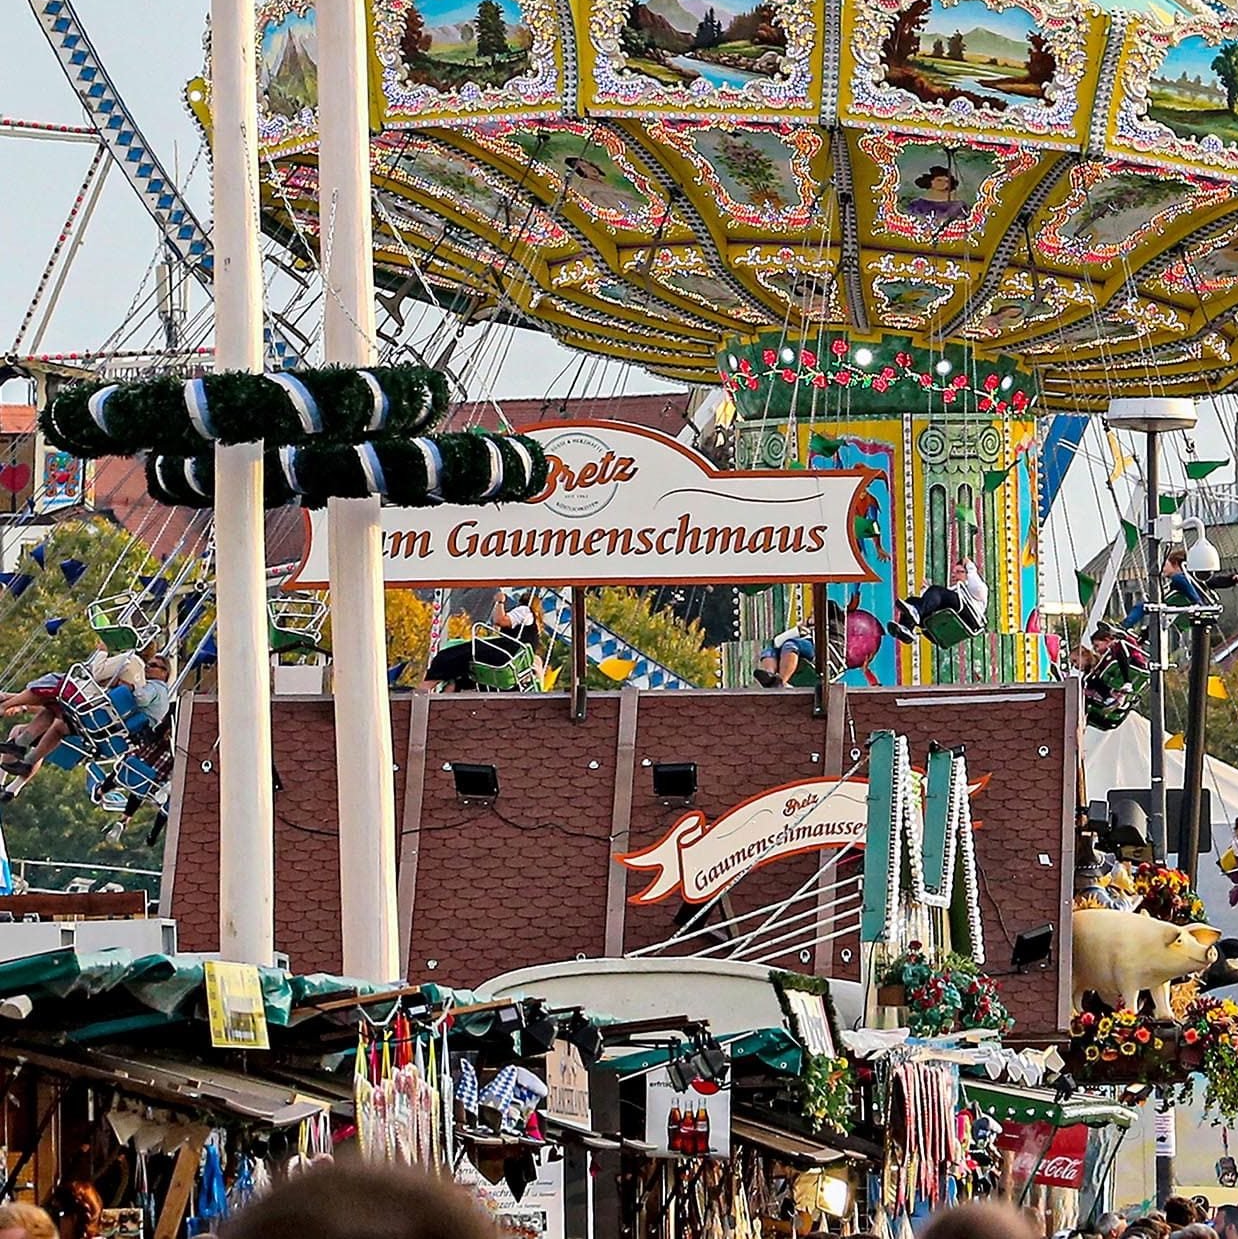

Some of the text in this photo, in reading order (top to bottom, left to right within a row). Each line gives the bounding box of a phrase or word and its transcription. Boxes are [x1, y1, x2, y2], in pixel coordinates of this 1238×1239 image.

[526, 450, 639, 504] Bretz
[447, 513, 829, 558] Gaumenschmaus
[782, 793, 819, 817] Bretz
